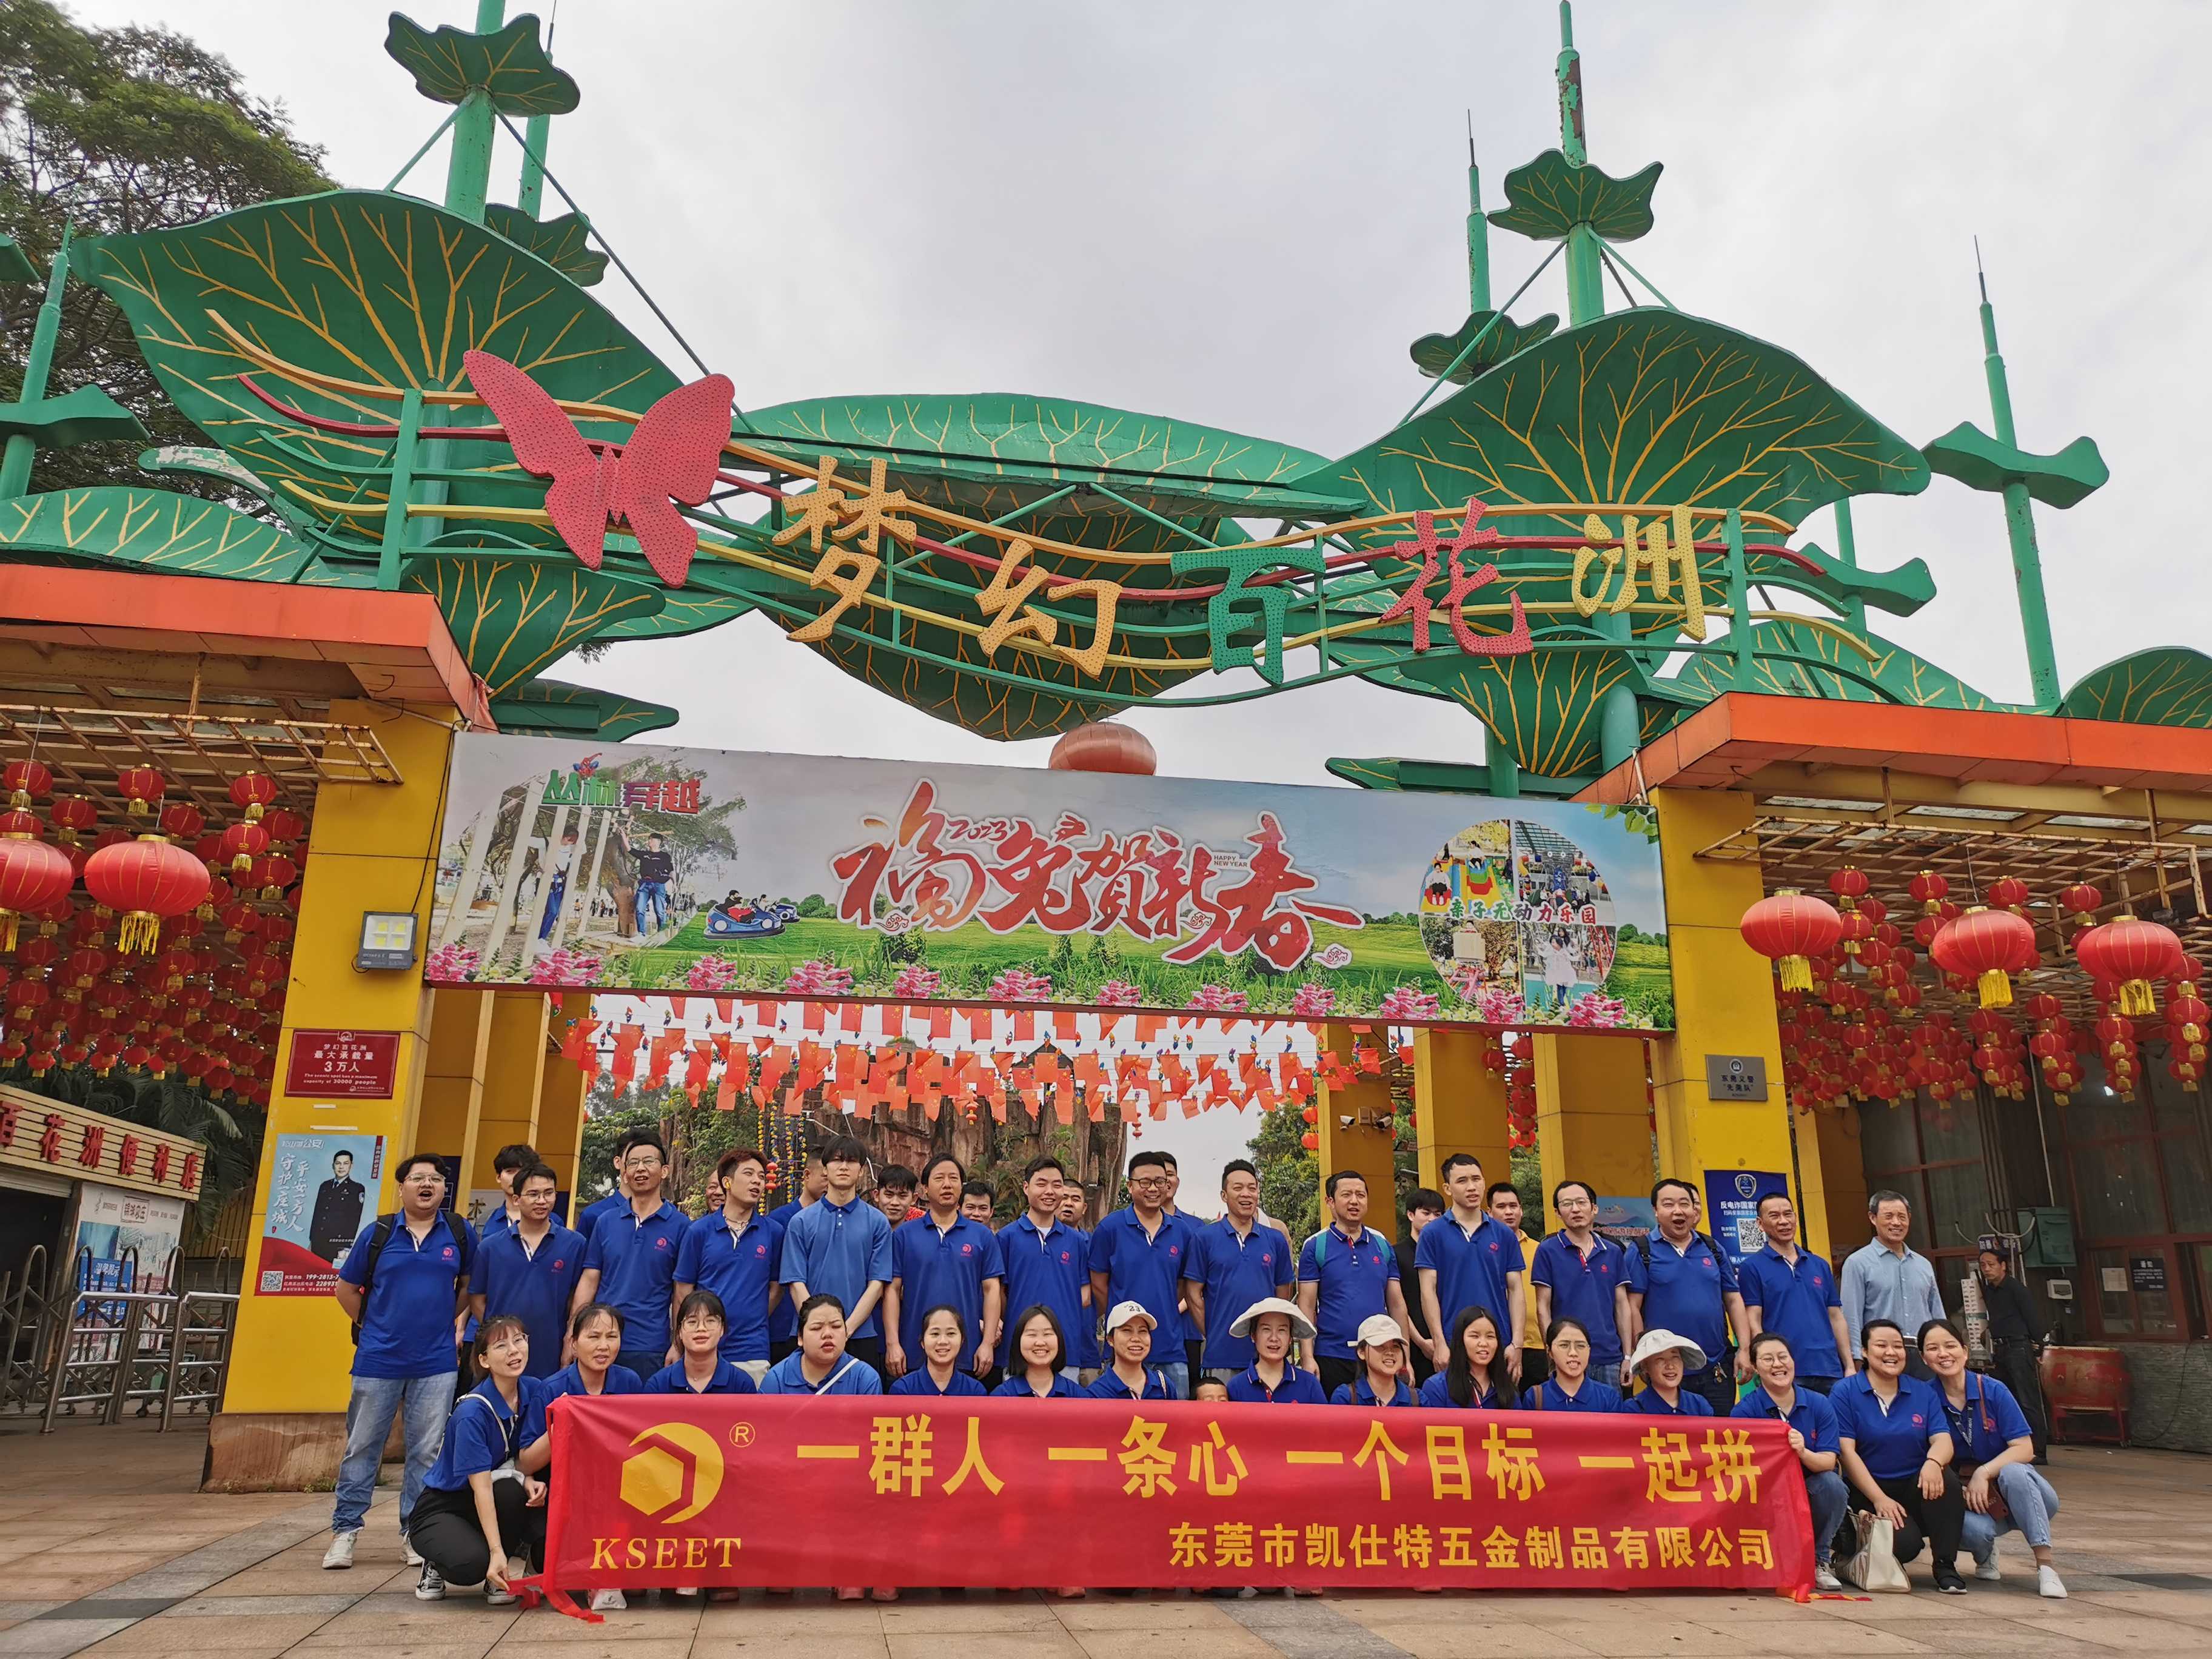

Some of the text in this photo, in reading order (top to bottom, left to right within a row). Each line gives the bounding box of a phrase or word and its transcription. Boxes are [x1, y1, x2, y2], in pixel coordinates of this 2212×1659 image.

[772, 455, 1707, 684] 梦幻百花洲
[541, 769, 700, 814] 丛林穿越
[947, 820, 1007, 841] 2023
[1450, 899, 1597, 925] 亲子无动力乐园
[313, 1050, 374, 1061] 最大承载量
[796, 1413, 1762, 1504] 一群人 一条心 一个目标 一起拼
[590, 1537, 742, 1569] KSEET
[1168, 1522, 1775, 1570] 东莞市凯仕特五金制品有限公司
